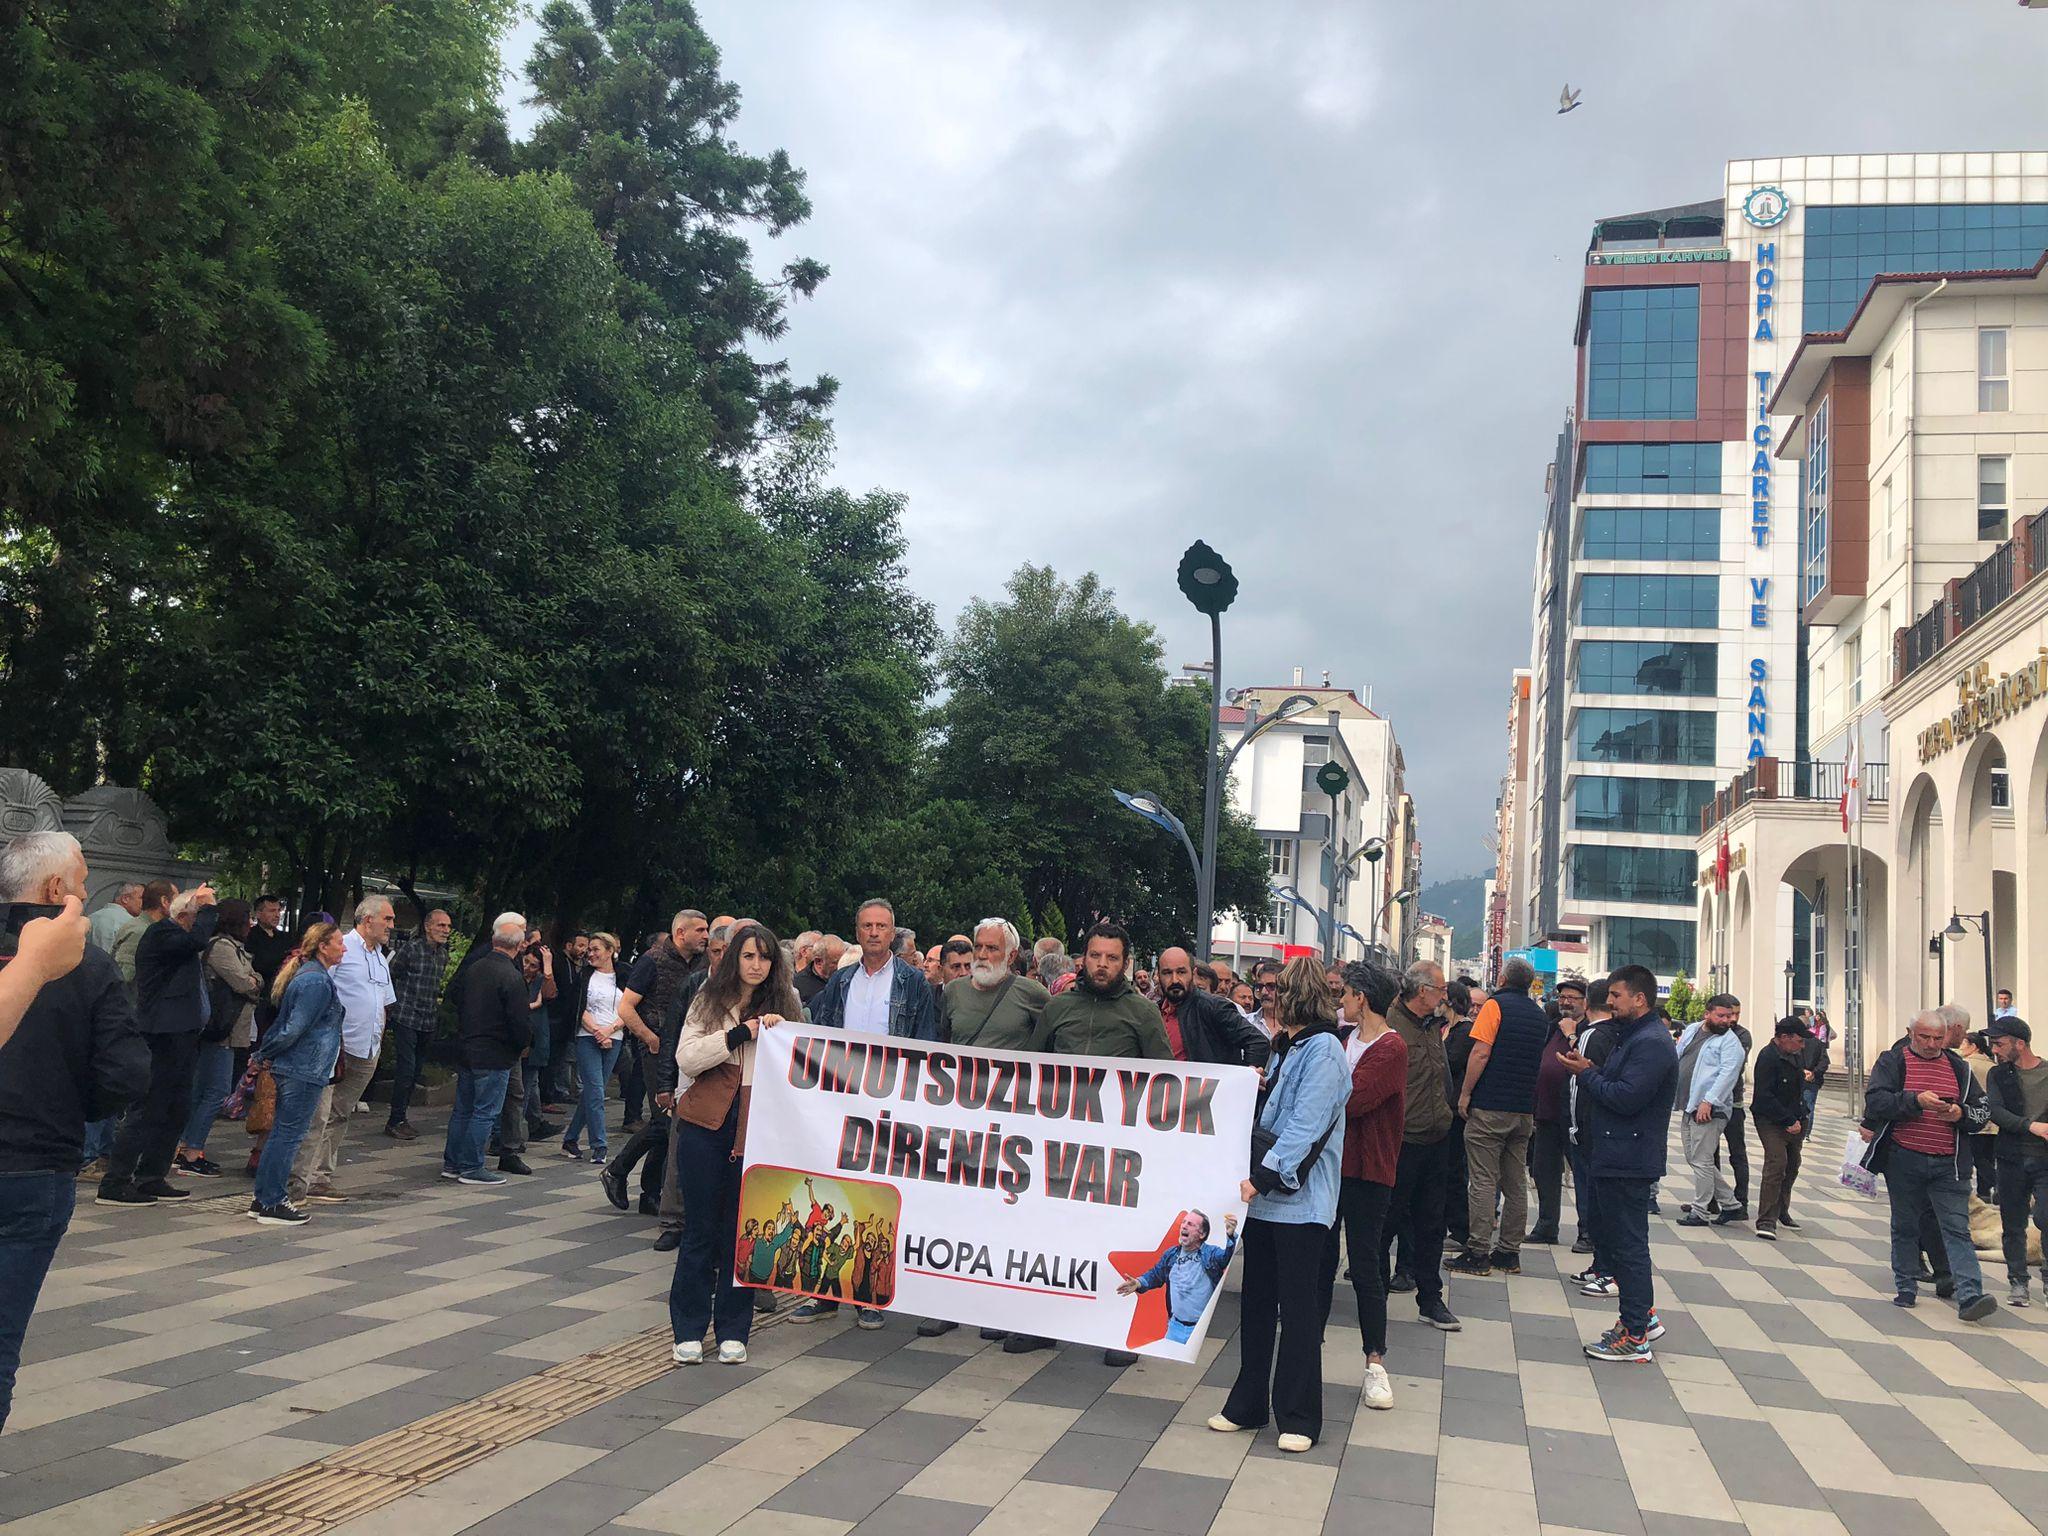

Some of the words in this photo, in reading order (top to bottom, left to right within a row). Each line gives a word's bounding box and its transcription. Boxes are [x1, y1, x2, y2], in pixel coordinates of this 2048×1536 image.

[1604, 253, 1657, 264] YEMEN
[1755, 243, 1774, 341] HOPA
[1750, 577, 1768, 627] VE
[1748, 658, 1766, 768] SANA
[788, 1036, 1108, 1124] UMUTSUZLUK
[1116, 1068, 1220, 1136] YOK
[837, 1110, 1033, 1205] DİRENİŞ
[1044, 1139, 1142, 1208] VAR
[904, 1234, 993, 1277] HOPA
[1005, 1248, 1098, 1292] HALKI
